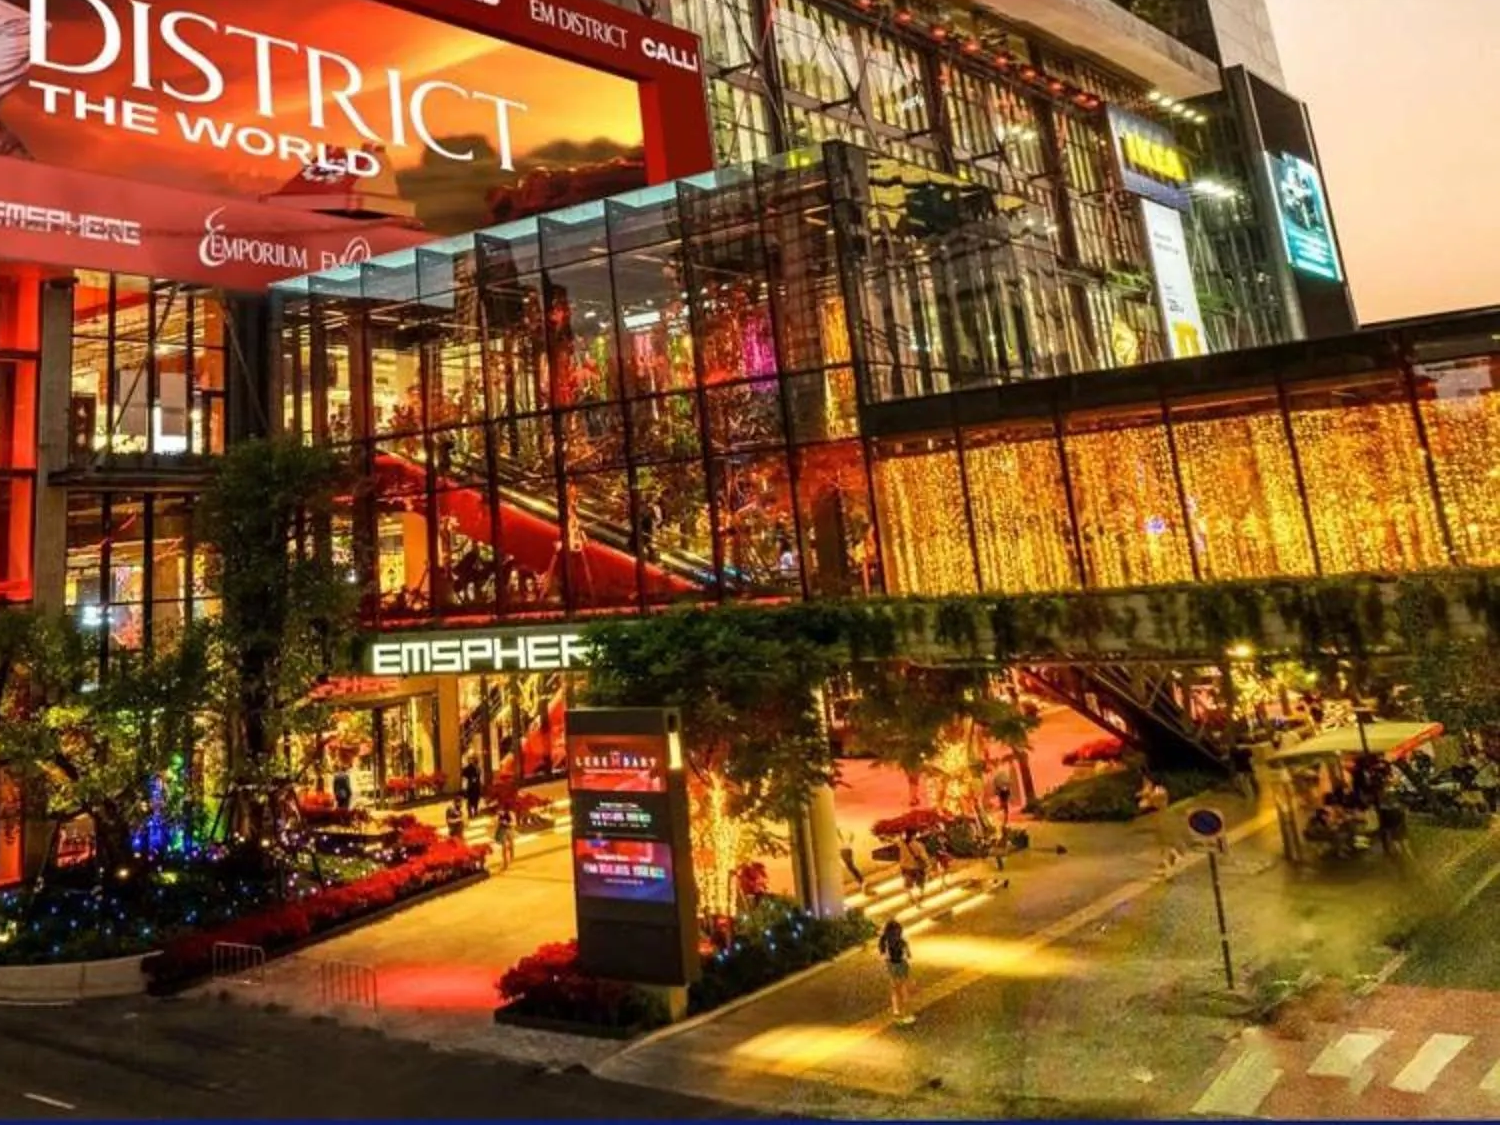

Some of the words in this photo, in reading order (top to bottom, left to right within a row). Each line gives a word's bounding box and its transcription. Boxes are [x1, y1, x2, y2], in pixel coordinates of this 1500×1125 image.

[558, 7, 628, 50] DISTRICT
[28, 80, 159, 135] THE
[176, 112, 380, 178] WORLD
[200, 206, 308, 270] EMPORIUM
[373, 635, 602, 674] EMSPHER
